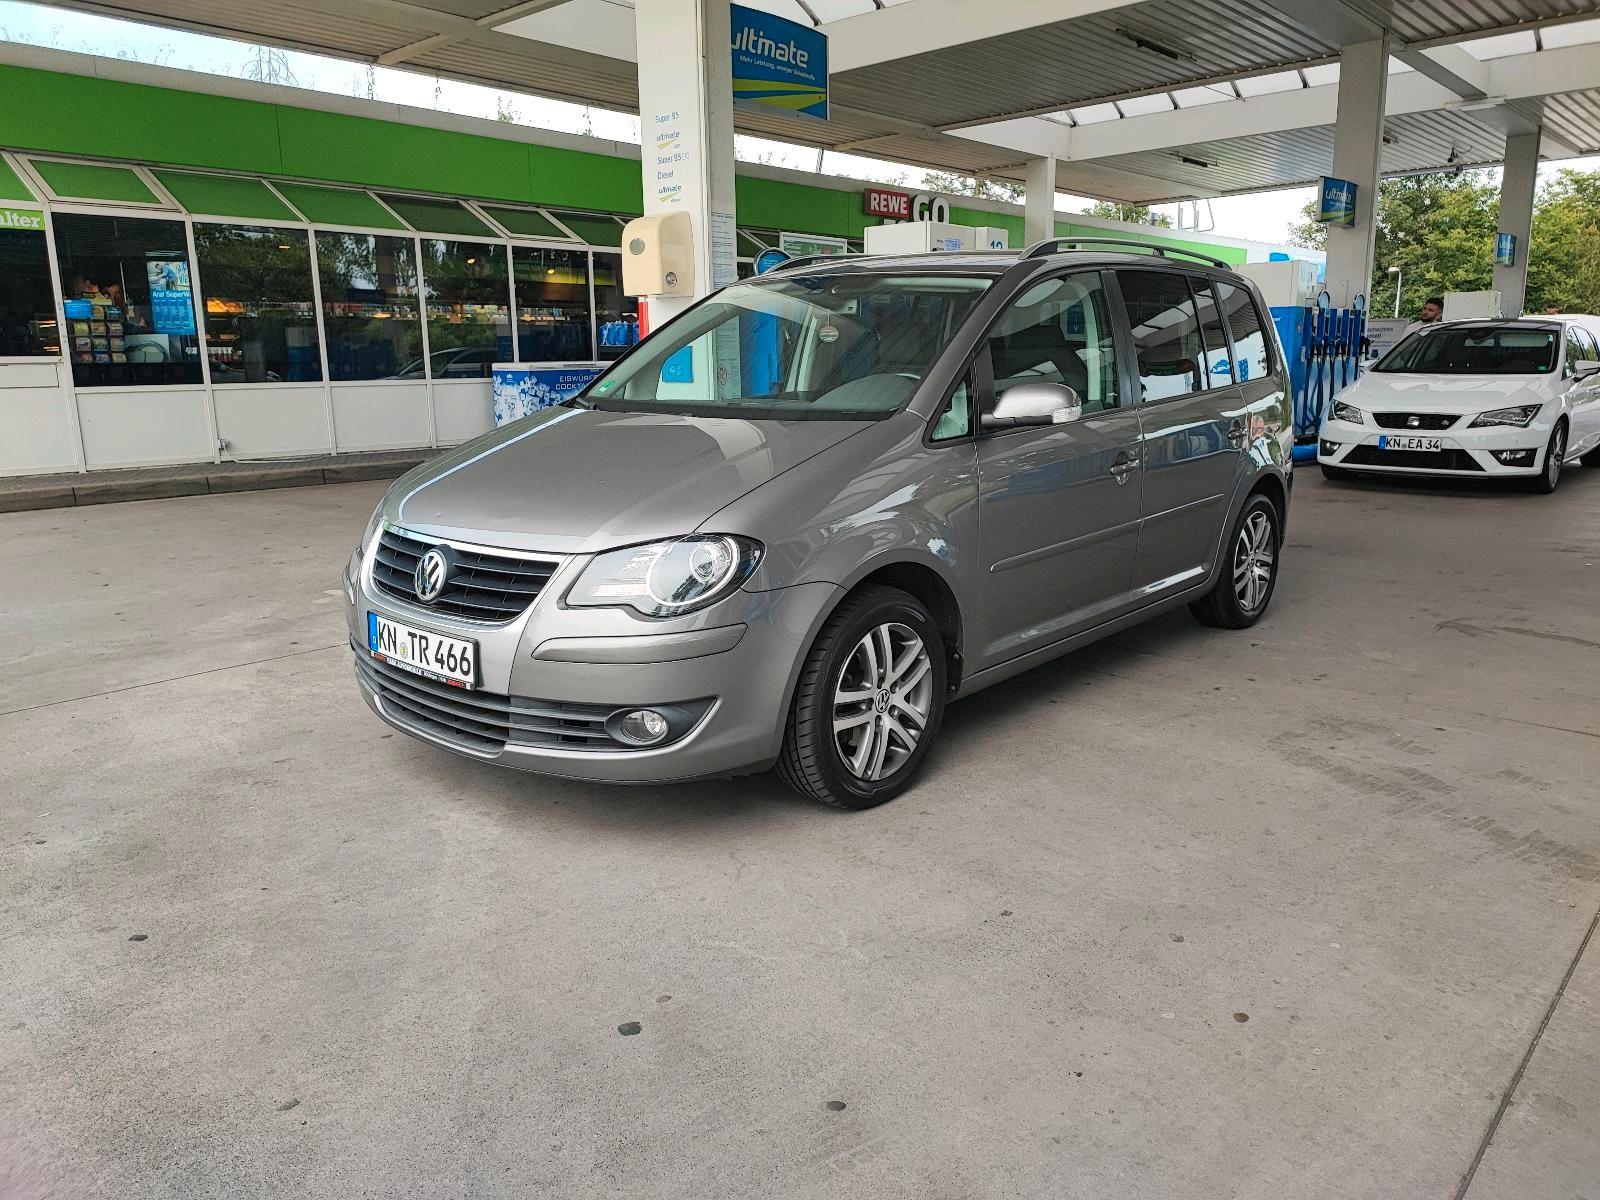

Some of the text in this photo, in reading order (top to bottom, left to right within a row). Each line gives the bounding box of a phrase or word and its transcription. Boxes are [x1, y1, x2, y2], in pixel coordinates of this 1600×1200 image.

[740, 54, 753, 64] Mehr
[656, 111, 680, 124] Super 95
[656, 131, 680, 141] ultimate
[657, 155, 673, 165] Super
[657, 170, 674, 180] Diesel
[658, 184, 682, 194] ultimate
[870, 192, 950, 225] REWE GO
[1385, 437, 1440, 450] KN EA 34
[378, 620, 398, 655] KN
[407, 630, 430, 666] TR
[434, 639, 471, 677] 466
